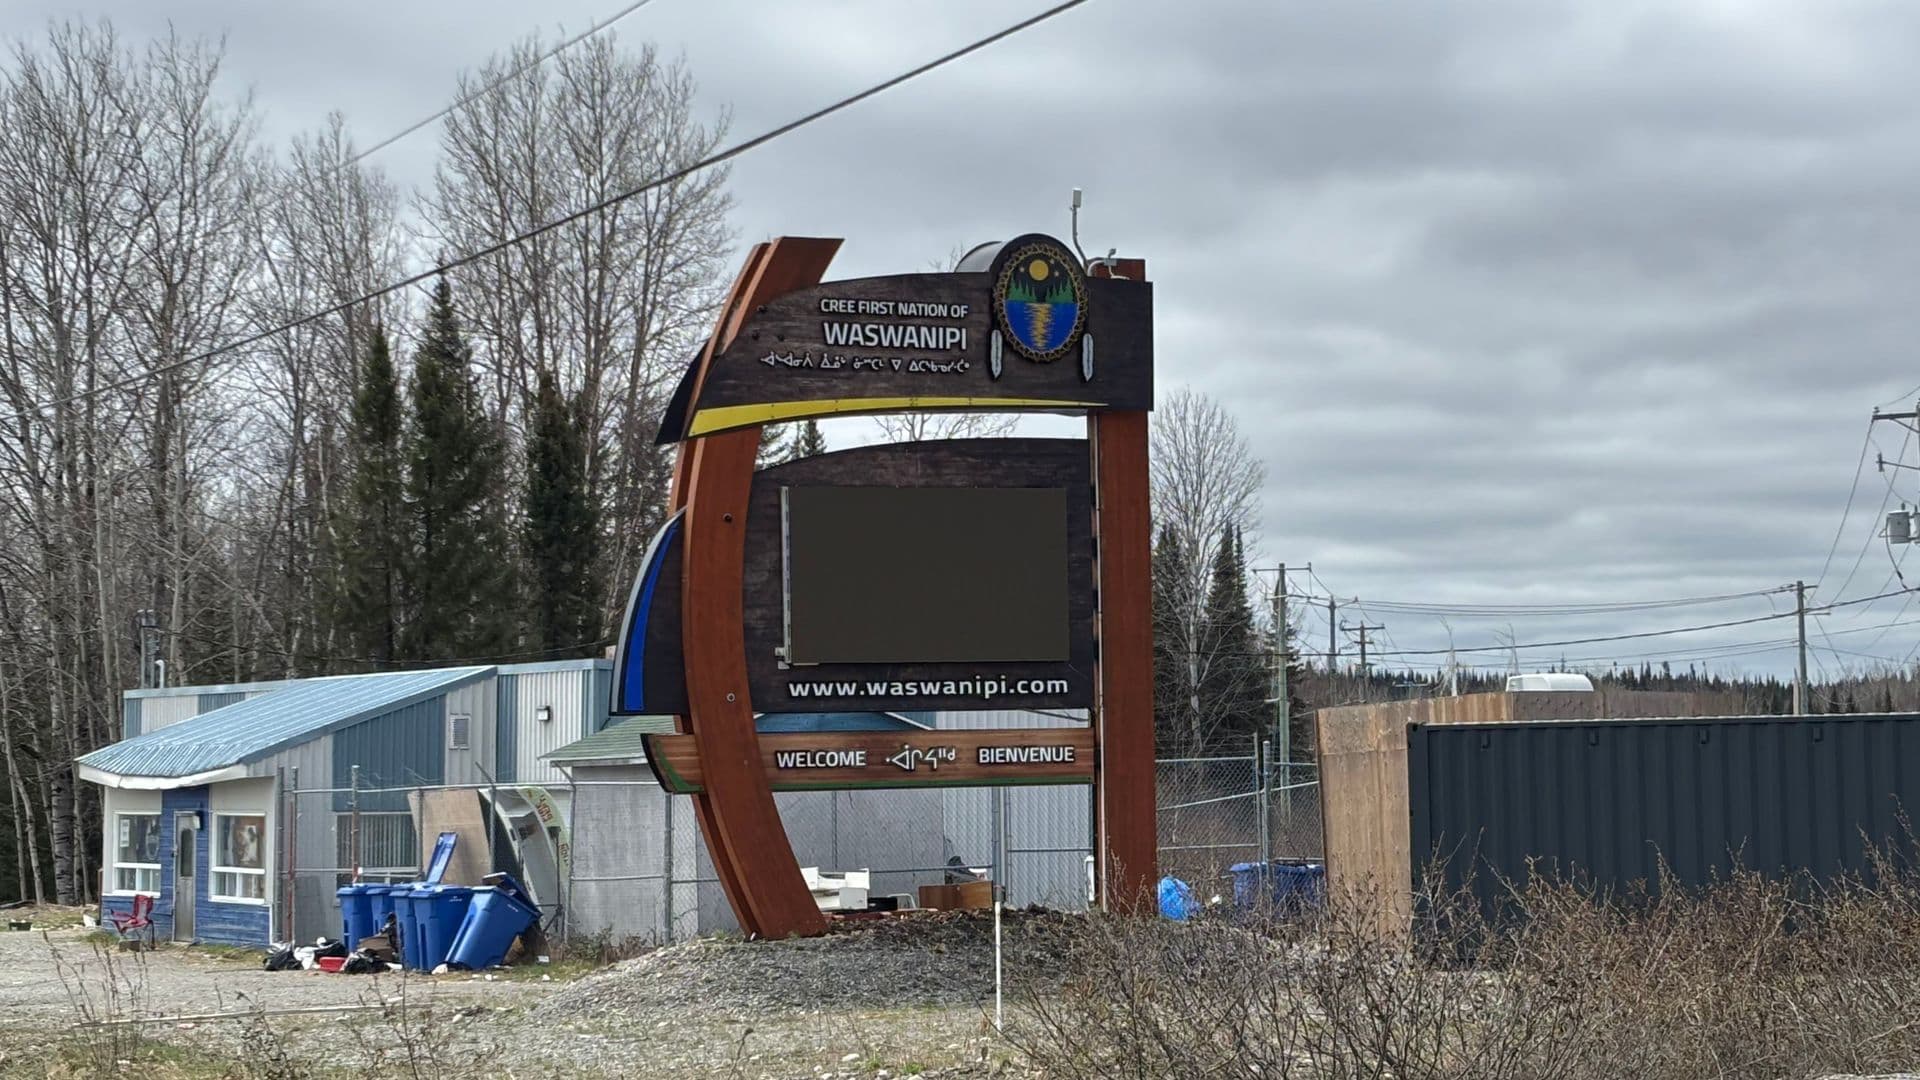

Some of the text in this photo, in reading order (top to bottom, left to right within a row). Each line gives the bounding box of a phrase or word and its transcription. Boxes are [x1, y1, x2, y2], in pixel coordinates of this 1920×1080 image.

[821, 299, 969, 318] CREE FIRST NATION OF
[823, 322, 966, 350] WASWANIPI
[789, 675, 1068, 699] www.waswanipi.com
[777, 751, 866, 768] WELCOME
[979, 746, 1074, 763] BIENVENUE
